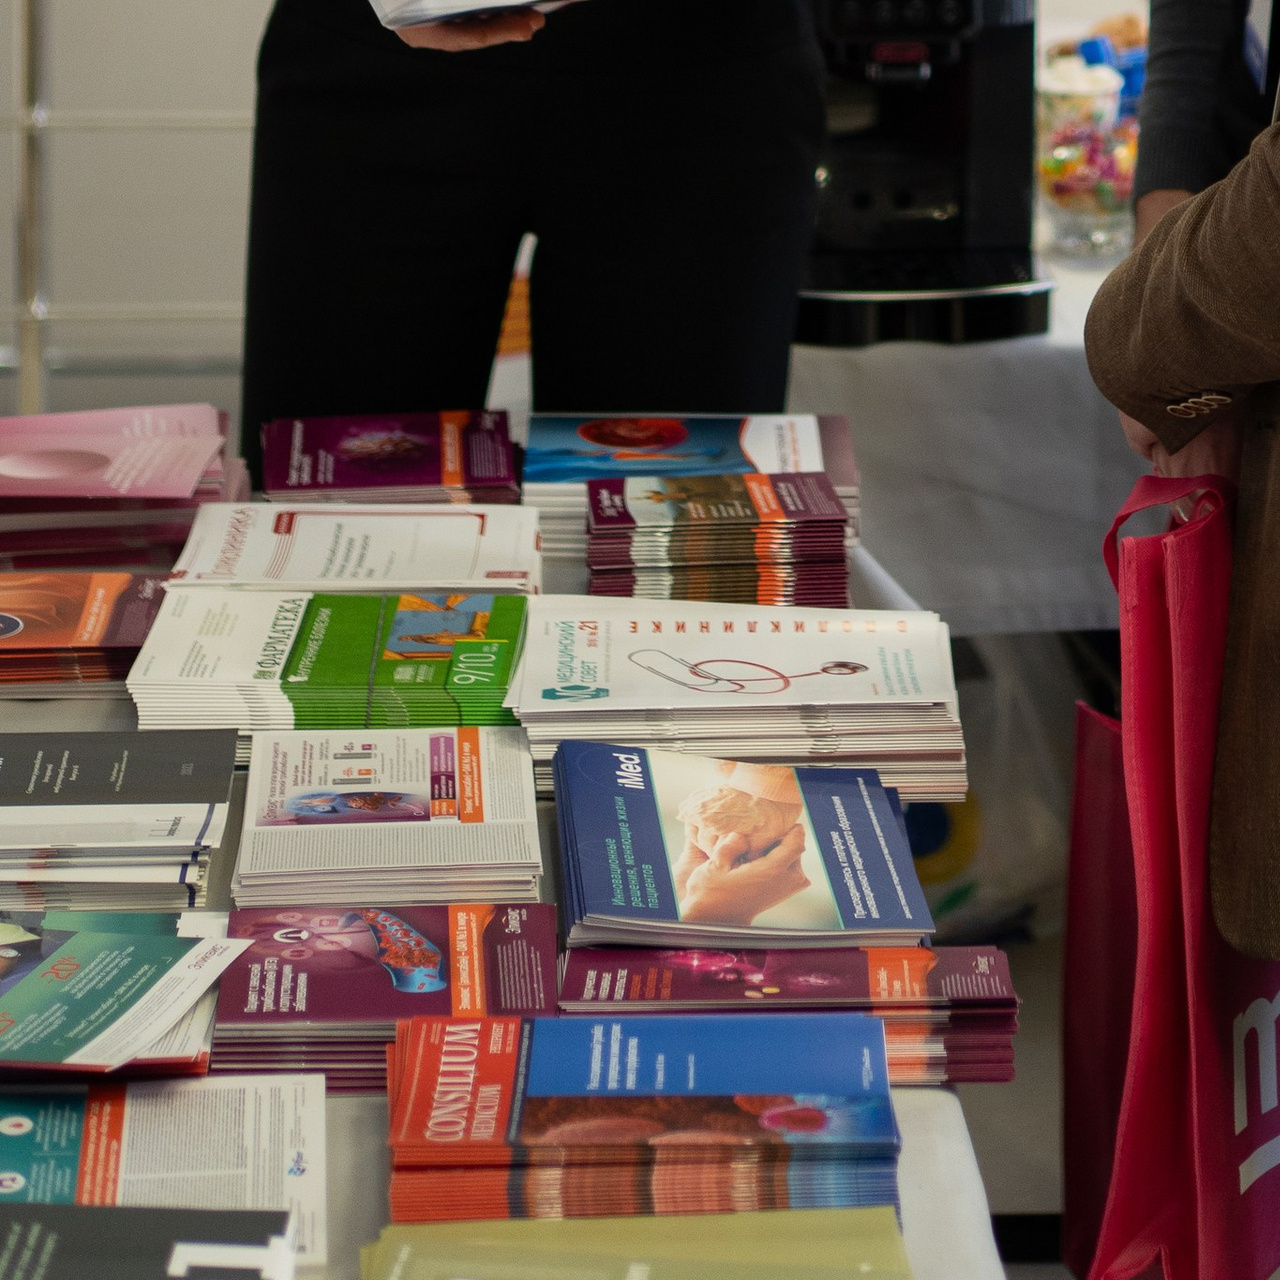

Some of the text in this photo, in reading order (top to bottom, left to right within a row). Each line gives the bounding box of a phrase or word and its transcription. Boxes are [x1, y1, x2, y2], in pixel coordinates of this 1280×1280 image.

[255, 598, 304, 669] ФАРМАТЕКА
[453, 653, 497, 685] 9/10
[605, 837, 626, 907] Инновационные
[613, 796, 646, 909] решения, меняющие жизни
[641, 863, 660, 909] пациентов
[424, 1022, 482, 1142] CONSILIUM
[469, 1084, 502, 1141] MEDICUM
